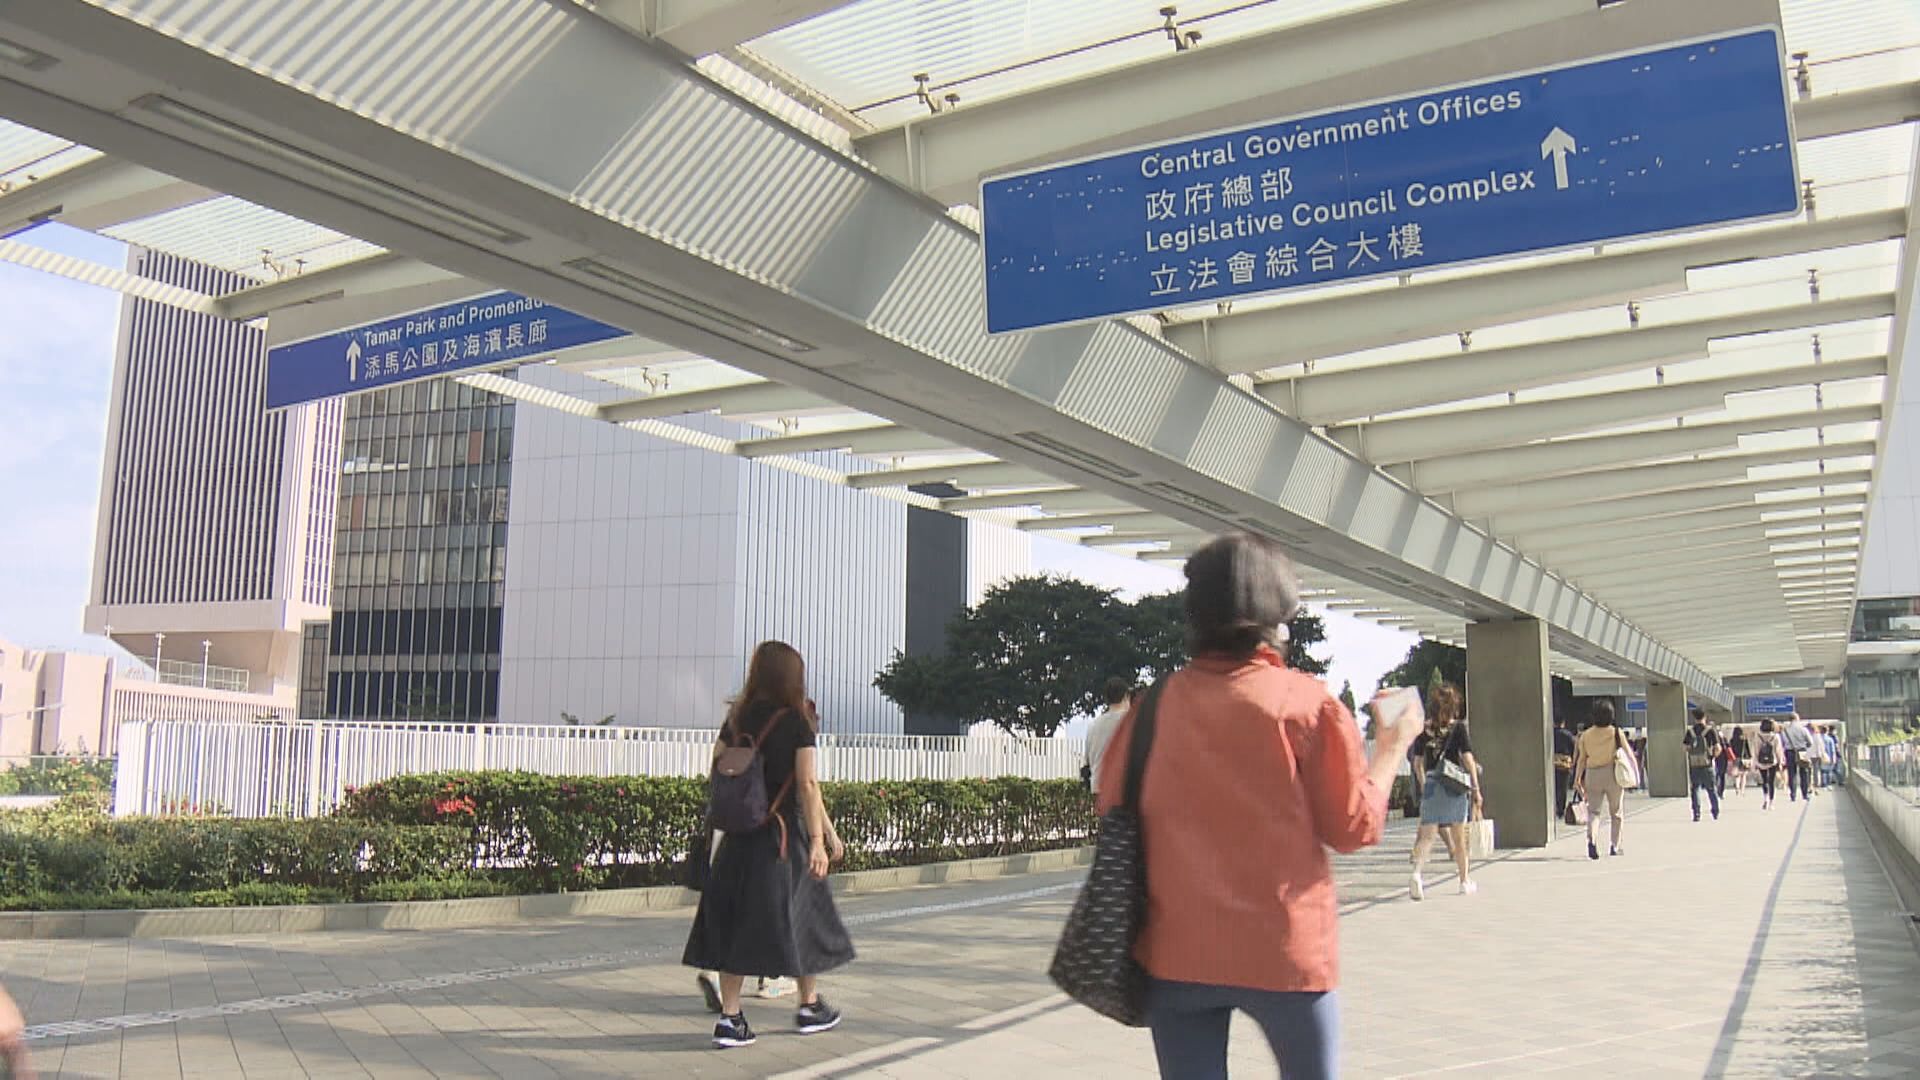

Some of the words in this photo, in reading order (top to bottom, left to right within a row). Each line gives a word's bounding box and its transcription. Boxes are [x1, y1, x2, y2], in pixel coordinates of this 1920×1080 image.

[1140, 141, 1236, 178] Central
[1244, 107, 1409, 159] Government
[1418, 89, 1522, 125] Offices
[1145, 166, 1294, 221] 政府總部
[1145, 213, 1284, 252] Legislative
[1292, 188, 1397, 226] Council
[1406, 169, 1536, 207] Complex
[1149, 223, 1424, 296] 立法會綜合大樓
[364, 327, 403, 348] Tamar
[405, 317, 436, 337] Park
[439, 307, 465, 329] and
[468, 297, 548, 324] Promenad
[364, 318, 548, 380] 添馬公園及海濱長廊
